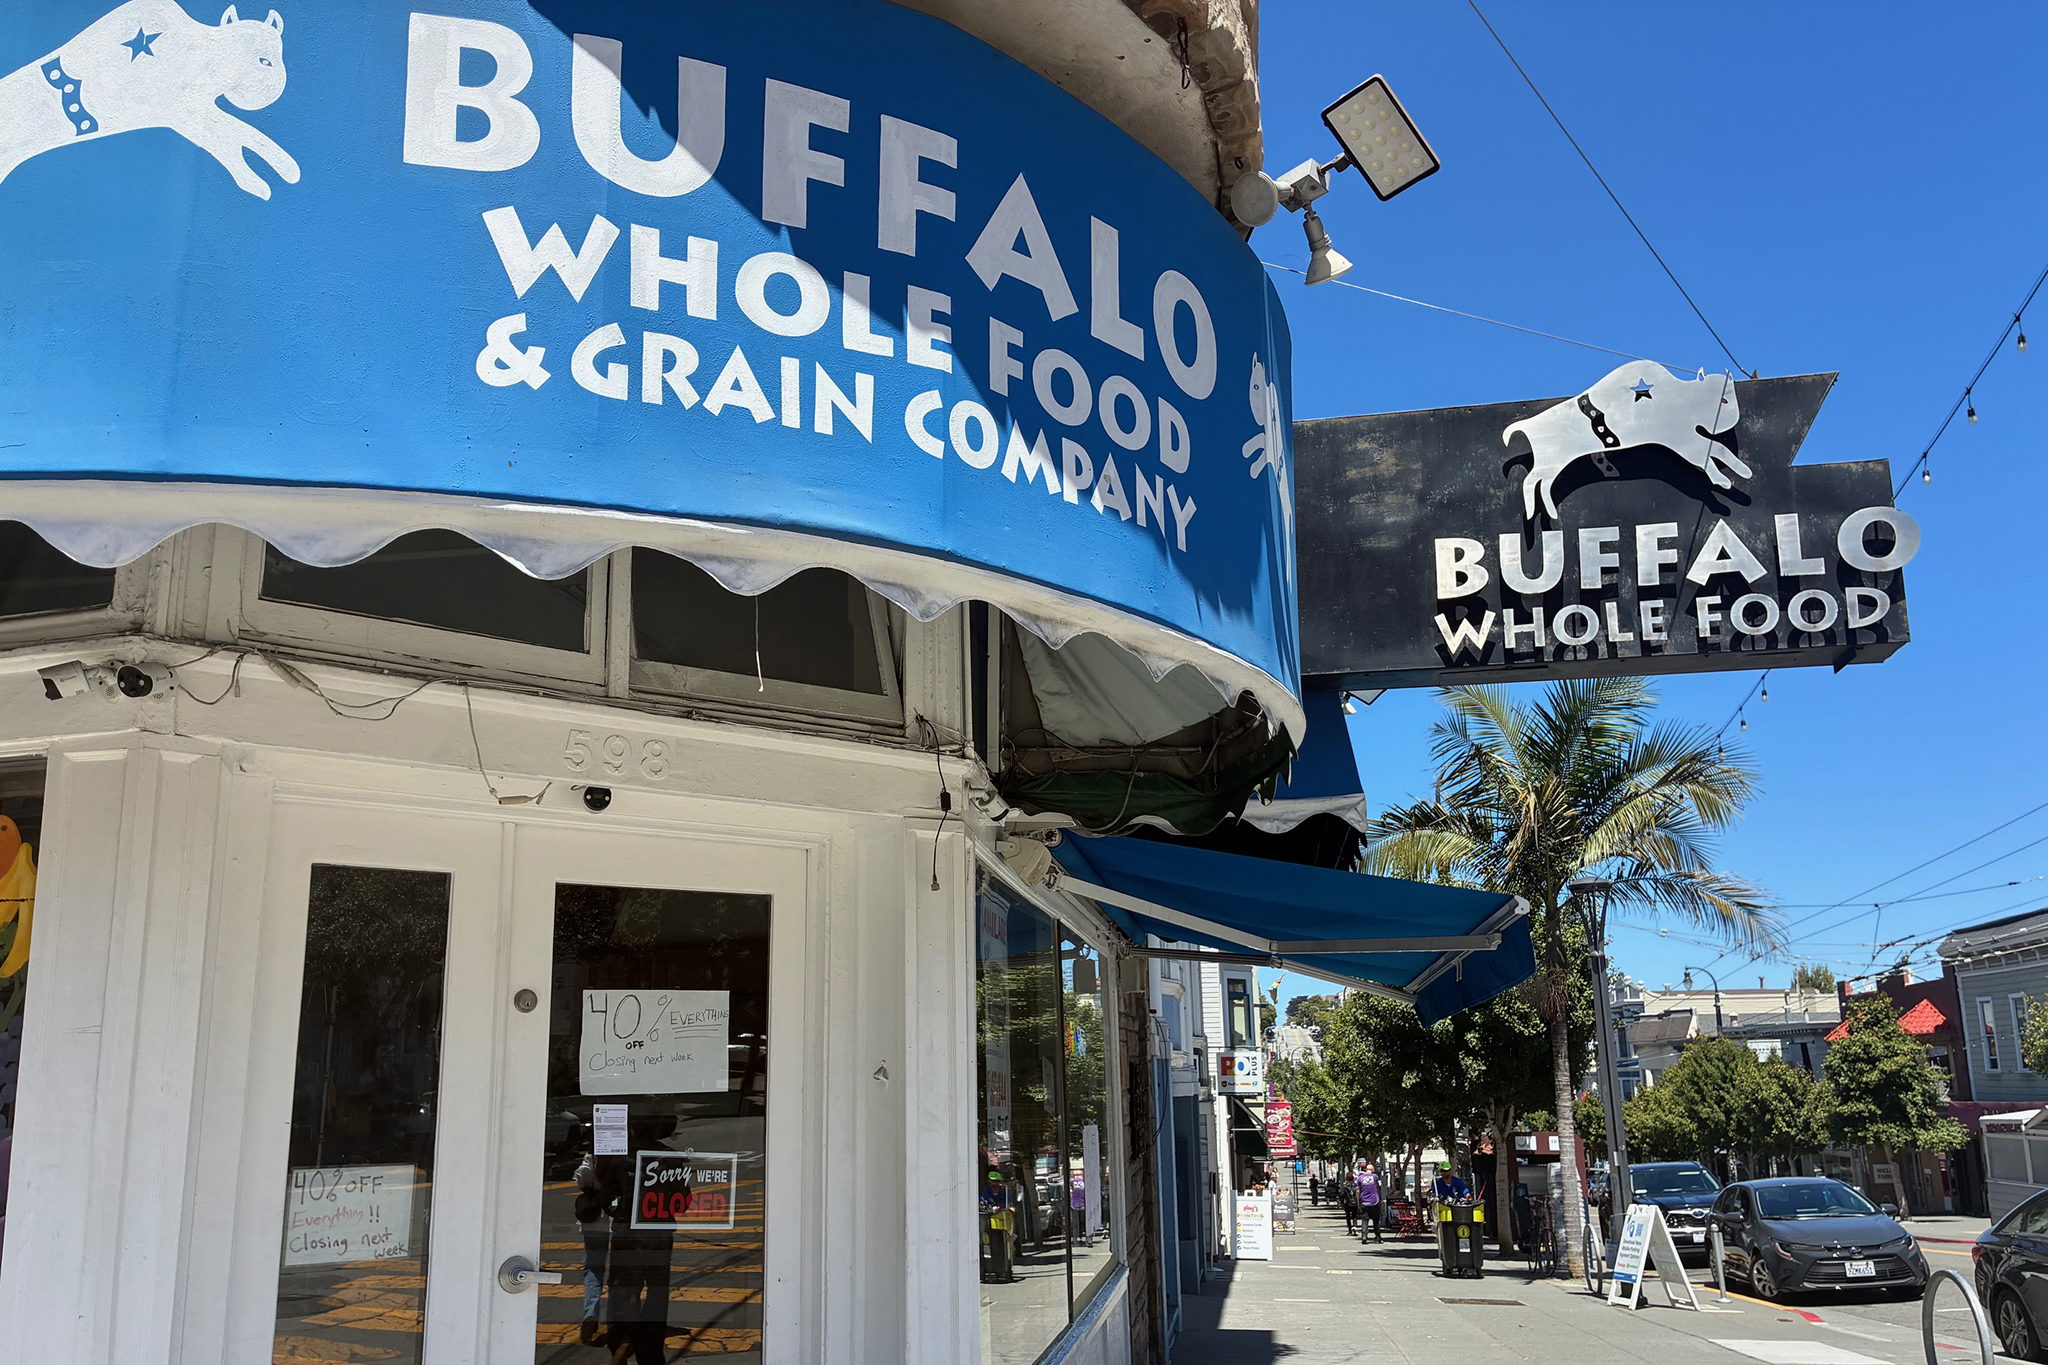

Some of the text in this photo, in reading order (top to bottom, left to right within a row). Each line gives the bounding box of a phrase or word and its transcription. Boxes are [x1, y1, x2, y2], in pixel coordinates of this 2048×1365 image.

[403, 12, 1217, 399] BUFFALO
[482, 206, 1190, 473] WHOLE FOOD
[476, 313, 1196, 551] & GRAIN COMPANY
[1435, 506, 1920, 599] BUFFALO
[1434, 587, 1890, 654] WHOLE FOOD
[564, 728, 671, 780] 598
[587, 993, 729, 1045] 40% EVERYTHING
[589, 1050, 636, 1073] Closing
[644, 1052, 664, 1065] next
[625, 1040, 645, 1050] OFF
[294, 1169, 343, 1205] 40%
[644, 1161, 728, 1186] Sorry WE'RE
[292, 1206, 364, 1230] Everything
[642, 1191, 726, 1218] CLOSED
[290, 1227, 393, 1255] Closing next
